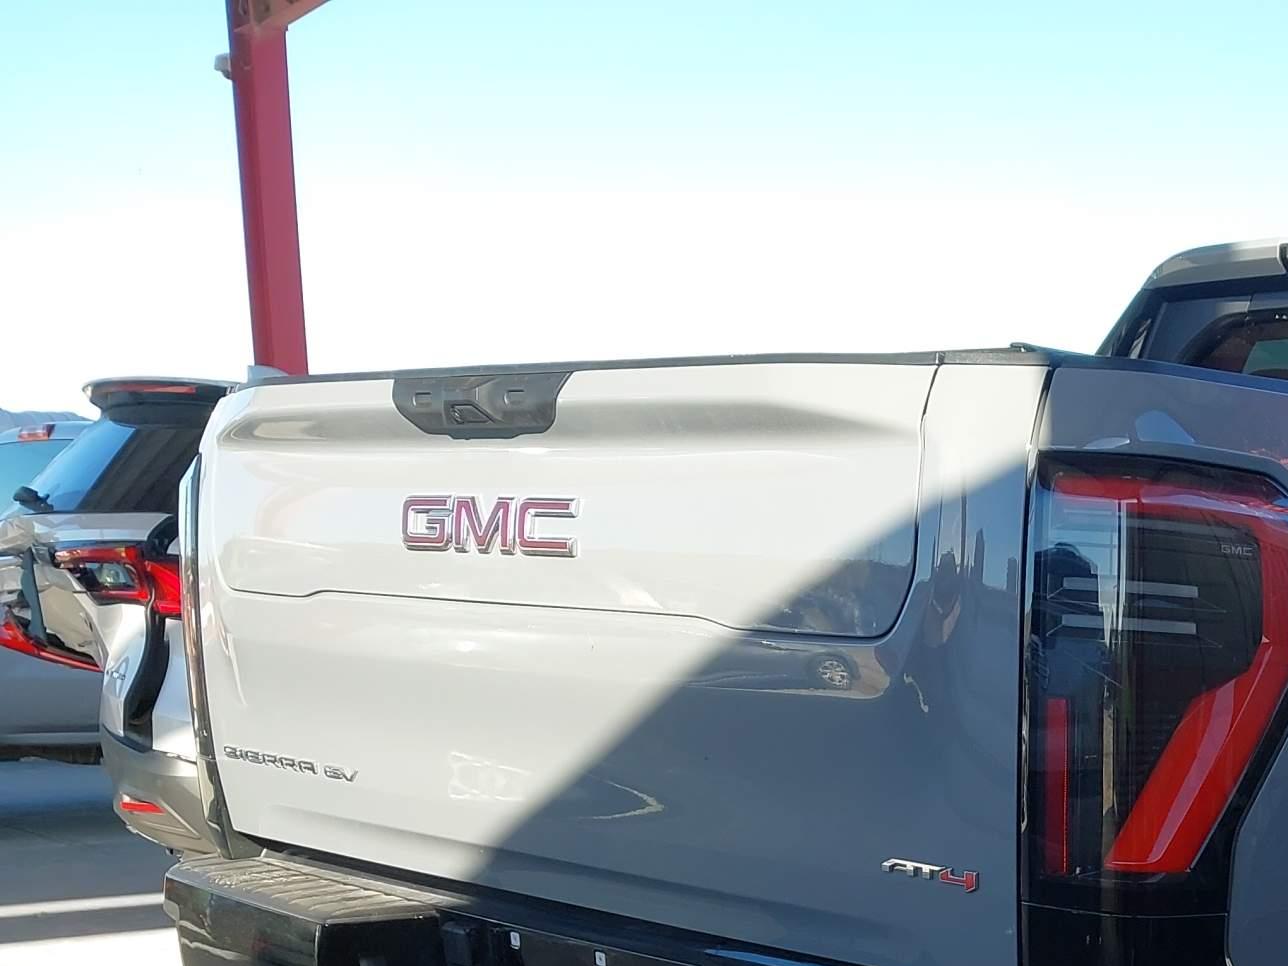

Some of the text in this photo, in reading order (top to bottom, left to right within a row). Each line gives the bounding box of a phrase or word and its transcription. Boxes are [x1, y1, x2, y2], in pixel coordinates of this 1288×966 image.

[402, 495, 577, 558] GMC
[1221, 544, 1253, 556] GMC
[223, 745, 359, 782] SIERRA EV
[881, 858, 979, 893] AT4
